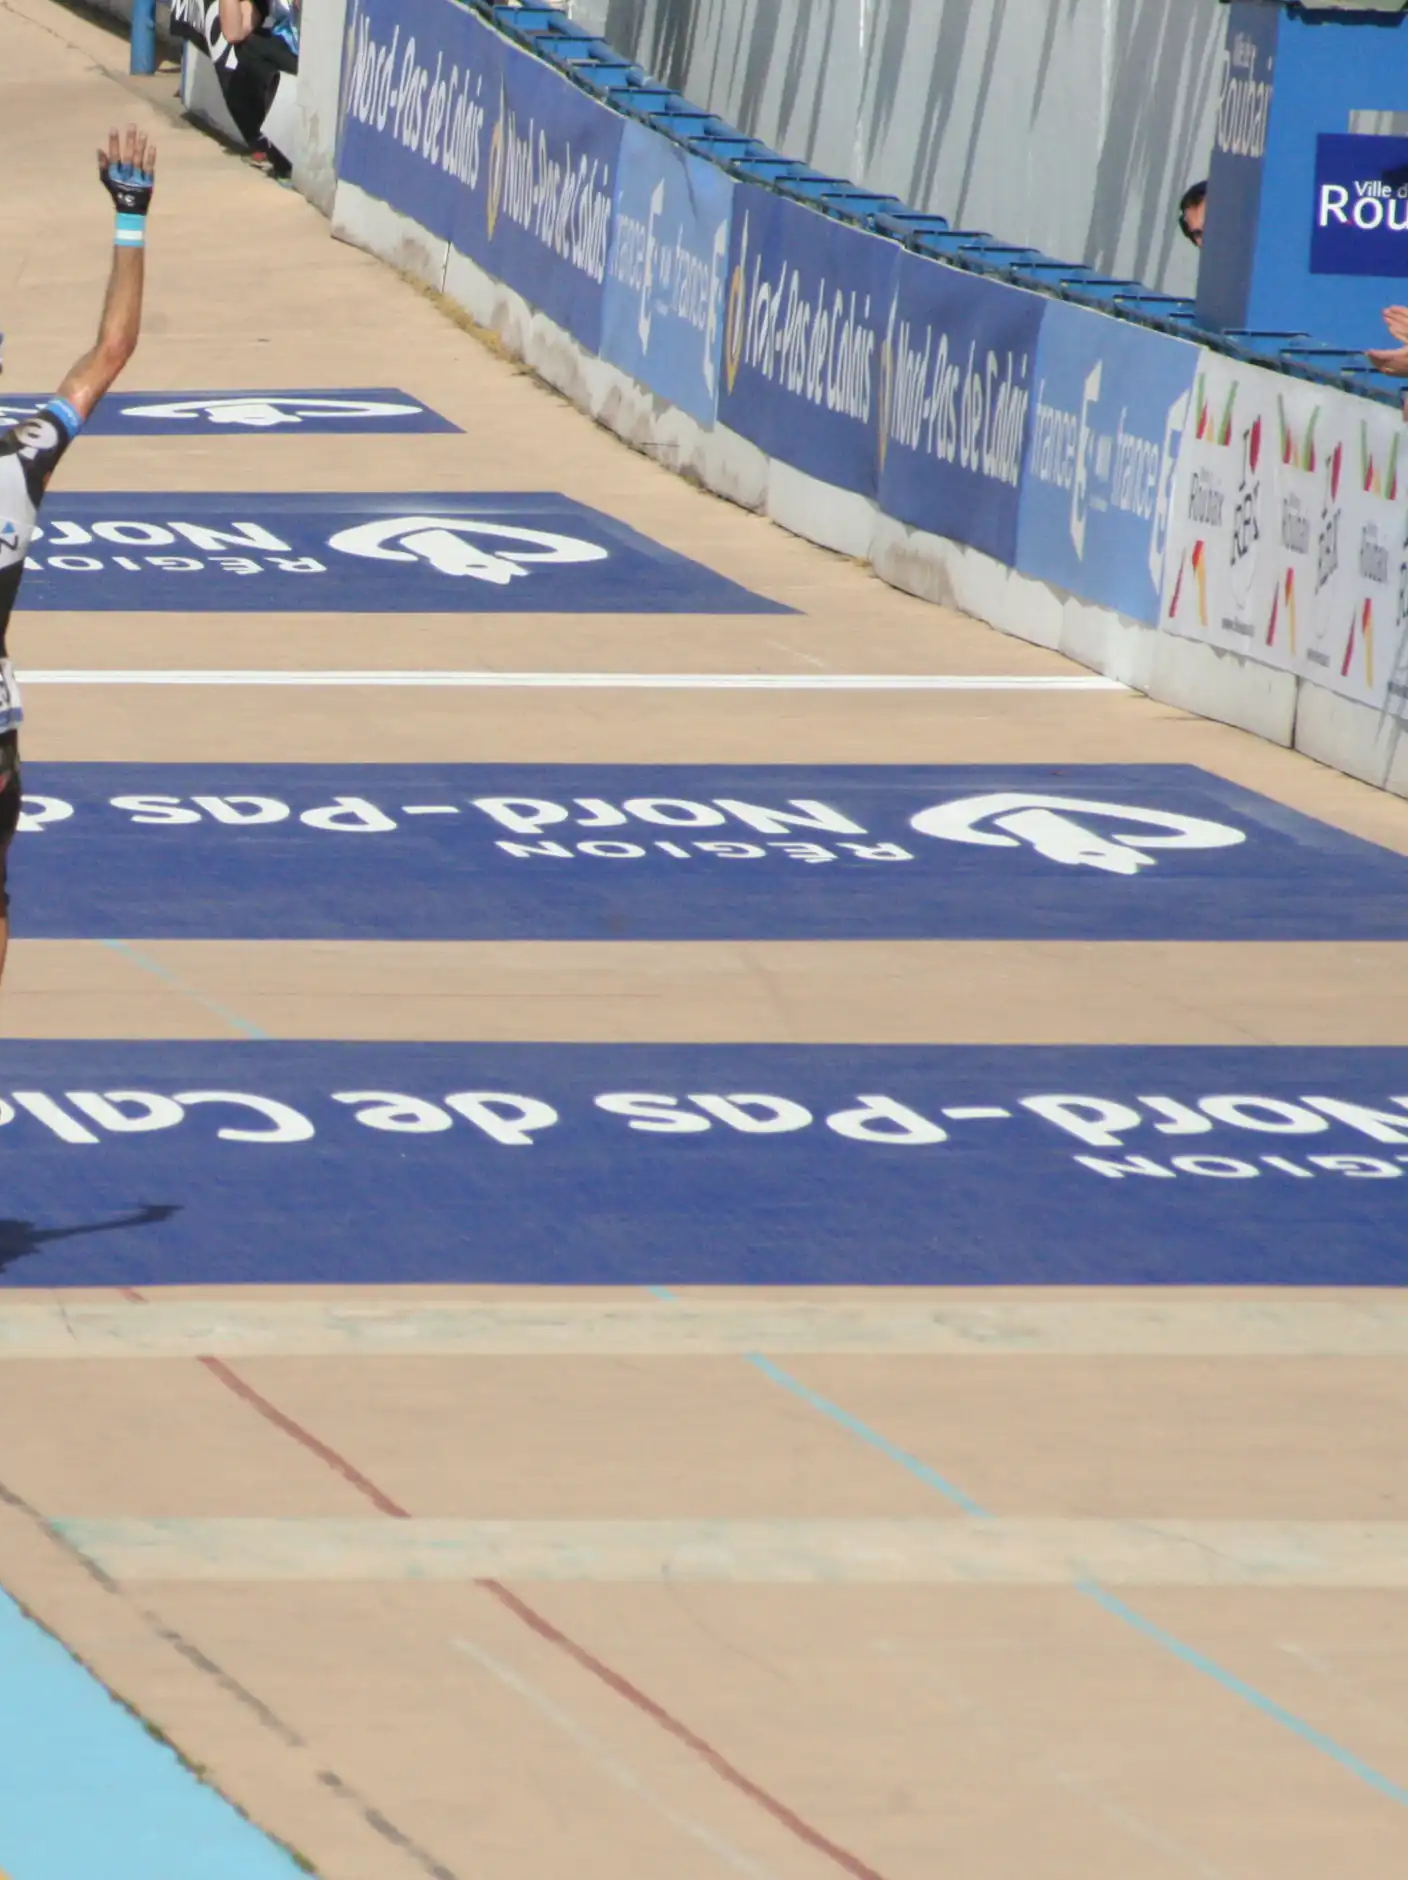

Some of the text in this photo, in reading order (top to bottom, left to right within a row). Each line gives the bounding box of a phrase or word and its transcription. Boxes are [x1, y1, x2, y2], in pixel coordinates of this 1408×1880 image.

[346, 13, 428, 151] Nord-Pas
[423, 50, 446, 165] de
[442, 65, 484, 190] Calais
[1219, 49, 1274, 158] Roubai
[555, 142, 577, 261] de
[571, 154, 612, 285] Calais
[1355, 180, 1392, 198] Ville
[806, 277, 829, 405] de
[827, 287, 875, 425] Calais
[960, 339, 983, 473] de
[983, 350, 1029, 488] Calais
[24, 555, 328, 576] RÉGIO
[108, 793, 869, 835] Nord-Pas
[494, 840, 915, 864] RÉGION
[329, 1089, 560, 1146] de
[1073, 1154, 1408, 1179] GION
